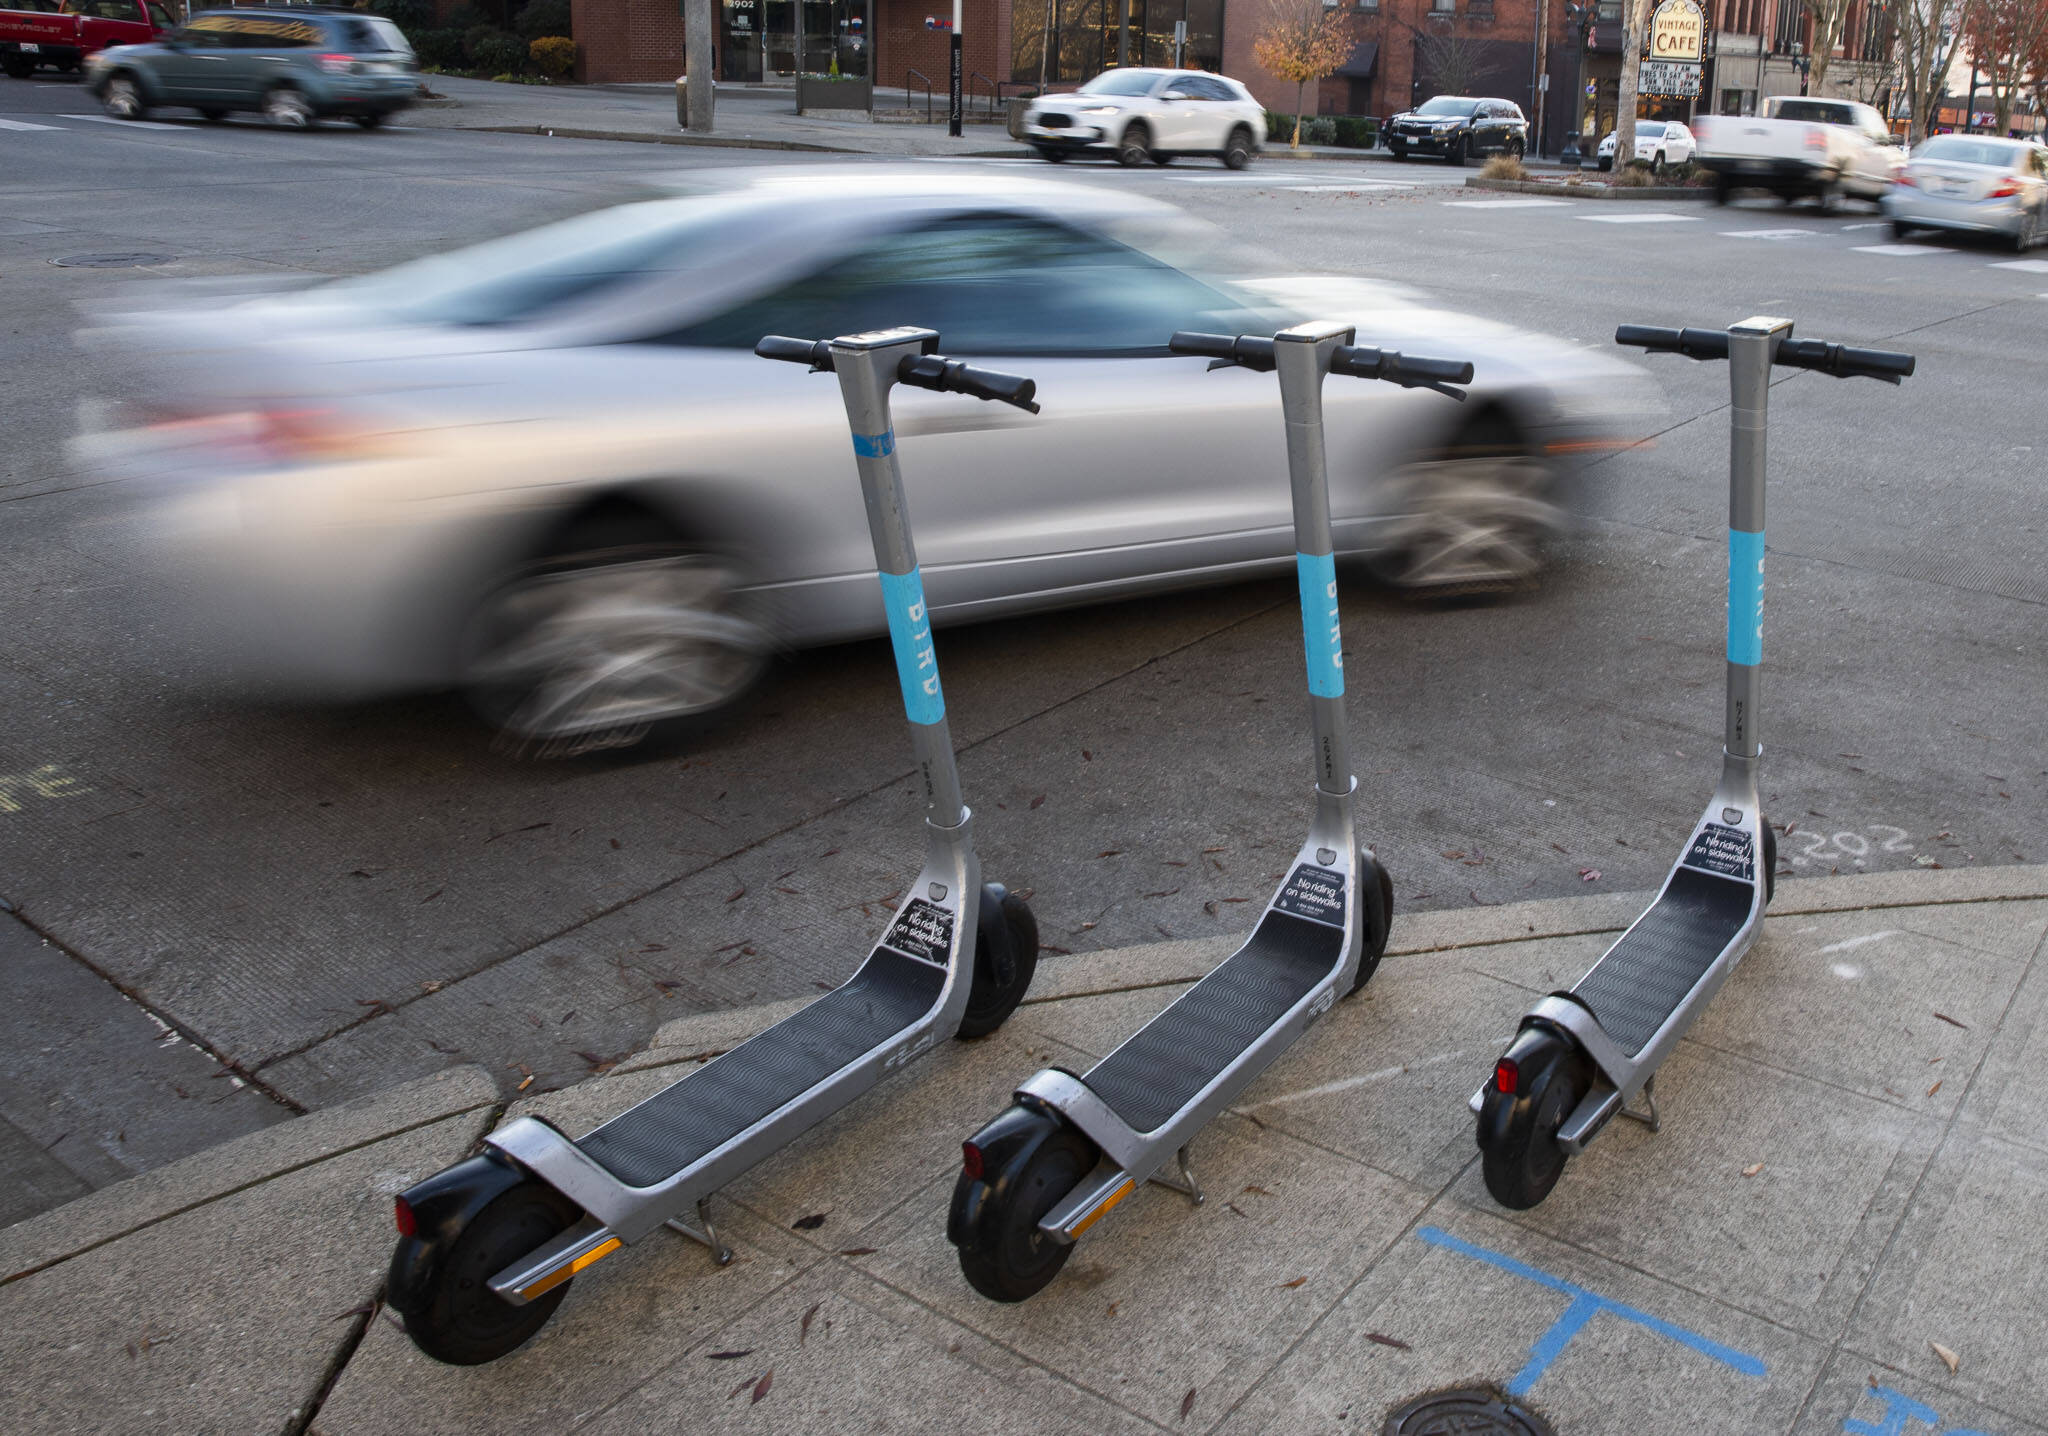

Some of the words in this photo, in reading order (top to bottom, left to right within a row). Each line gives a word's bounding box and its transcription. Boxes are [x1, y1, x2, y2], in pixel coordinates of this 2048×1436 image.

[1658, 19, 1698, 31] VINTAGE
[1656, 32, 1697, 52] CAFE
[952, 48, 961, 77] Everett
[1651, 63, 1669, 71] OPEN
[951, 78, 961, 121] Downtown
[1679, 87, 1699, 95] CHIPS
[908, 595, 939, 696] BIRD
[1694, 845, 1707, 855] on
[1707, 847, 1751, 865] sidewalks
[1706, 836, 1720, 847] No
[1719, 839, 1745, 854] riding
[1297, 877, 1311, 890] No
[1311, 881, 1337, 898] riding
[1286, 887, 1298, 897] on
[1300, 890, 1342, 909] sidewalks
[908, 912, 921, 926] No
[897, 923, 909, 934] on
[909, 926, 948, 948] sidewalks
